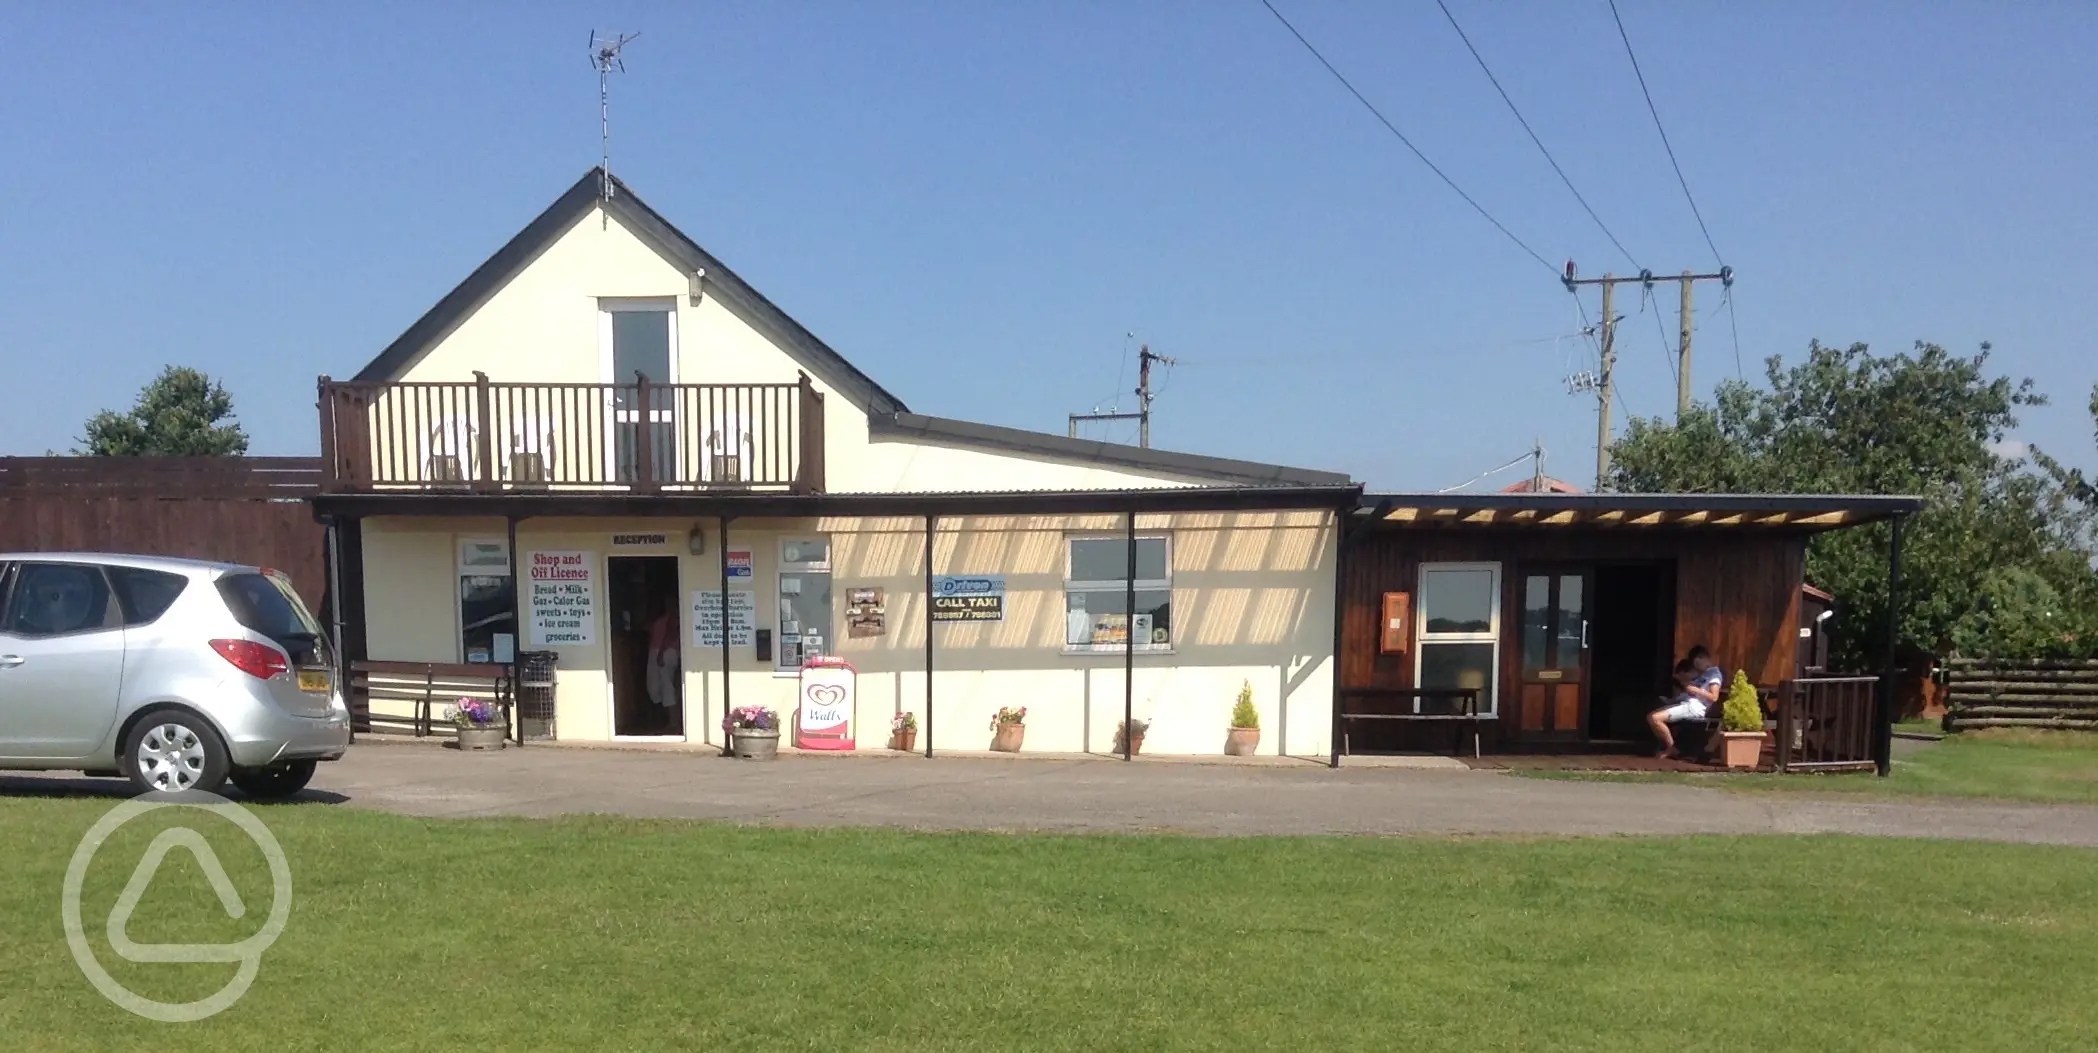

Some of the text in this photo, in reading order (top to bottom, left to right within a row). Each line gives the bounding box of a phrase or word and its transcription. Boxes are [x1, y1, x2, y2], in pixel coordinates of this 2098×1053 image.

[613, 534, 666, 545] RECEPTION
[534, 553, 581, 566] Shop and
[531, 567, 588, 578] Off Licence
[534, 585, 583, 594] Bread Milk
[553, 596, 574, 605] Calor
[575, 596, 590, 605] Gas
[936, 598, 998, 607] CALL TAXI
[536, 608, 585, 618] sweets toys
[557, 619, 580, 628] cream
[545, 632, 580, 643] groceries
